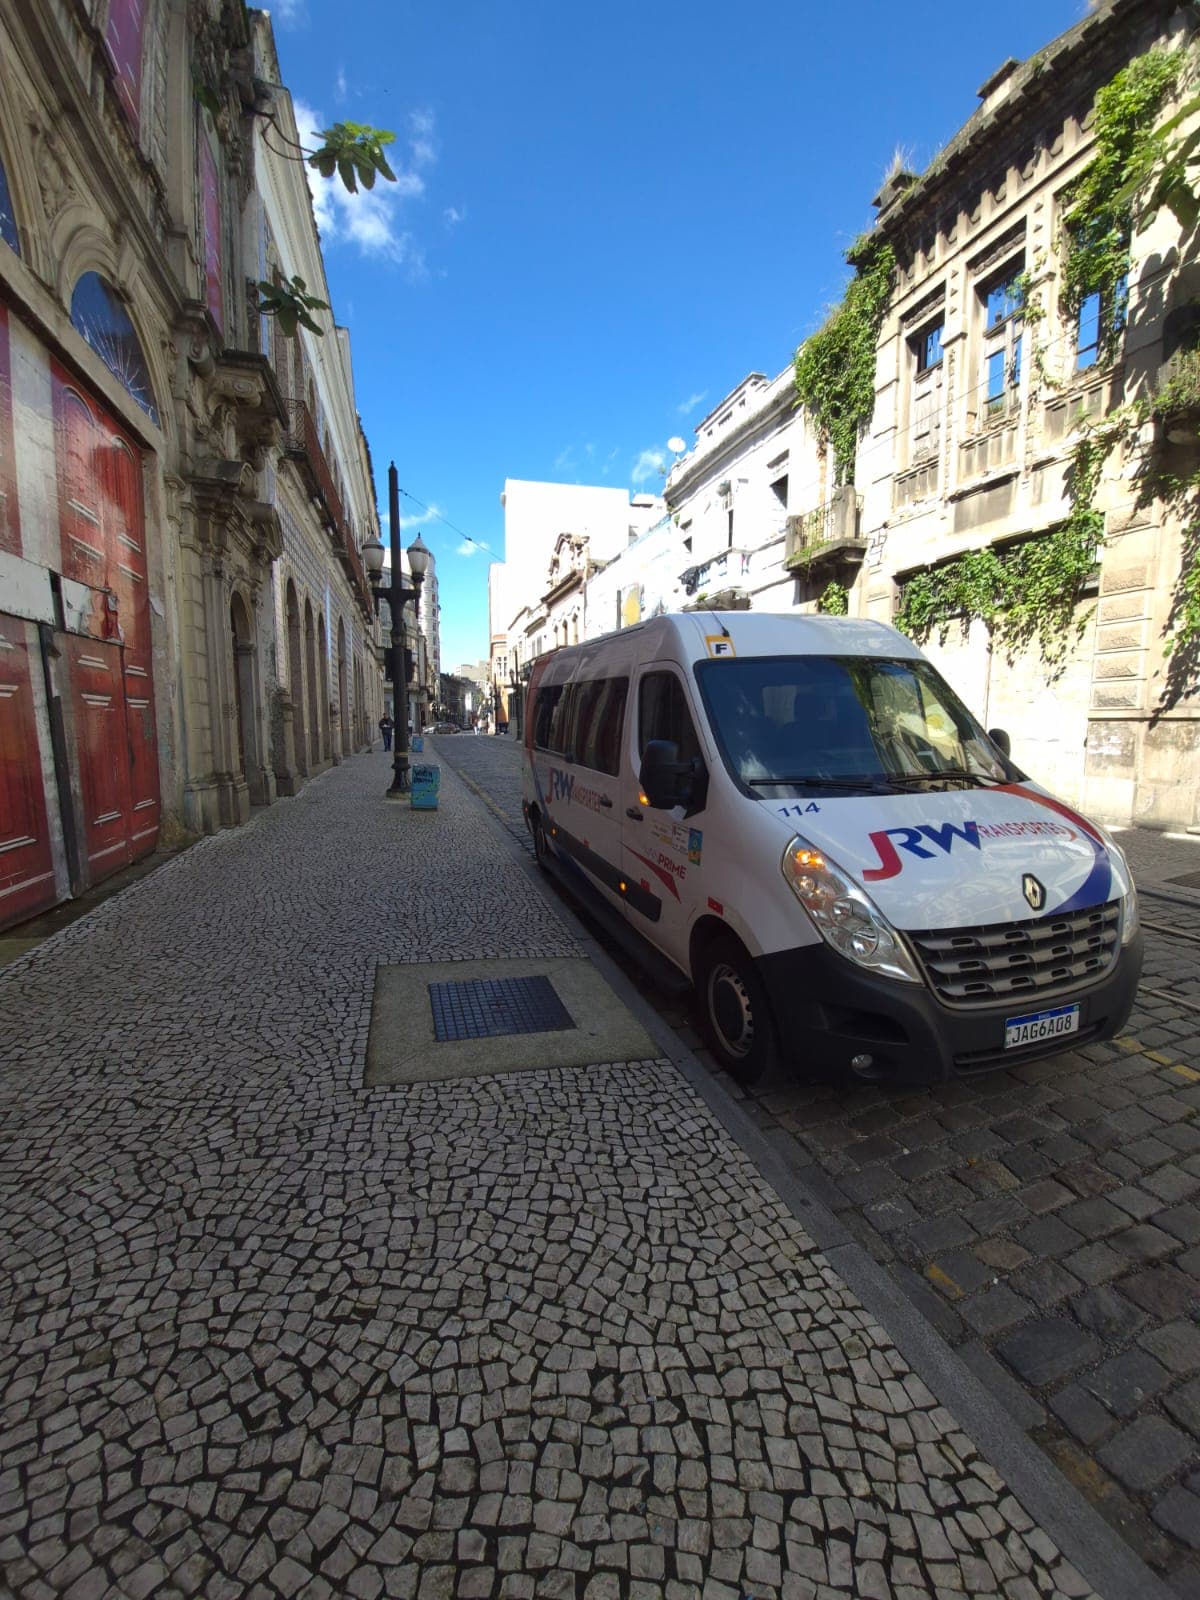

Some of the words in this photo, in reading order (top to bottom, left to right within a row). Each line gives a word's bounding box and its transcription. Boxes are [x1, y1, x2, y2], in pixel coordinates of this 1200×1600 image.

[715, 643, 728, 655] F
[778, 802, 821, 818] 114
[862, 821, 982, 882] JRW
[977, 822, 1066, 840] TRANSPORTES
[658, 853, 687, 880] PRIME
[1012, 1014, 1072, 1043] JAG6A08
